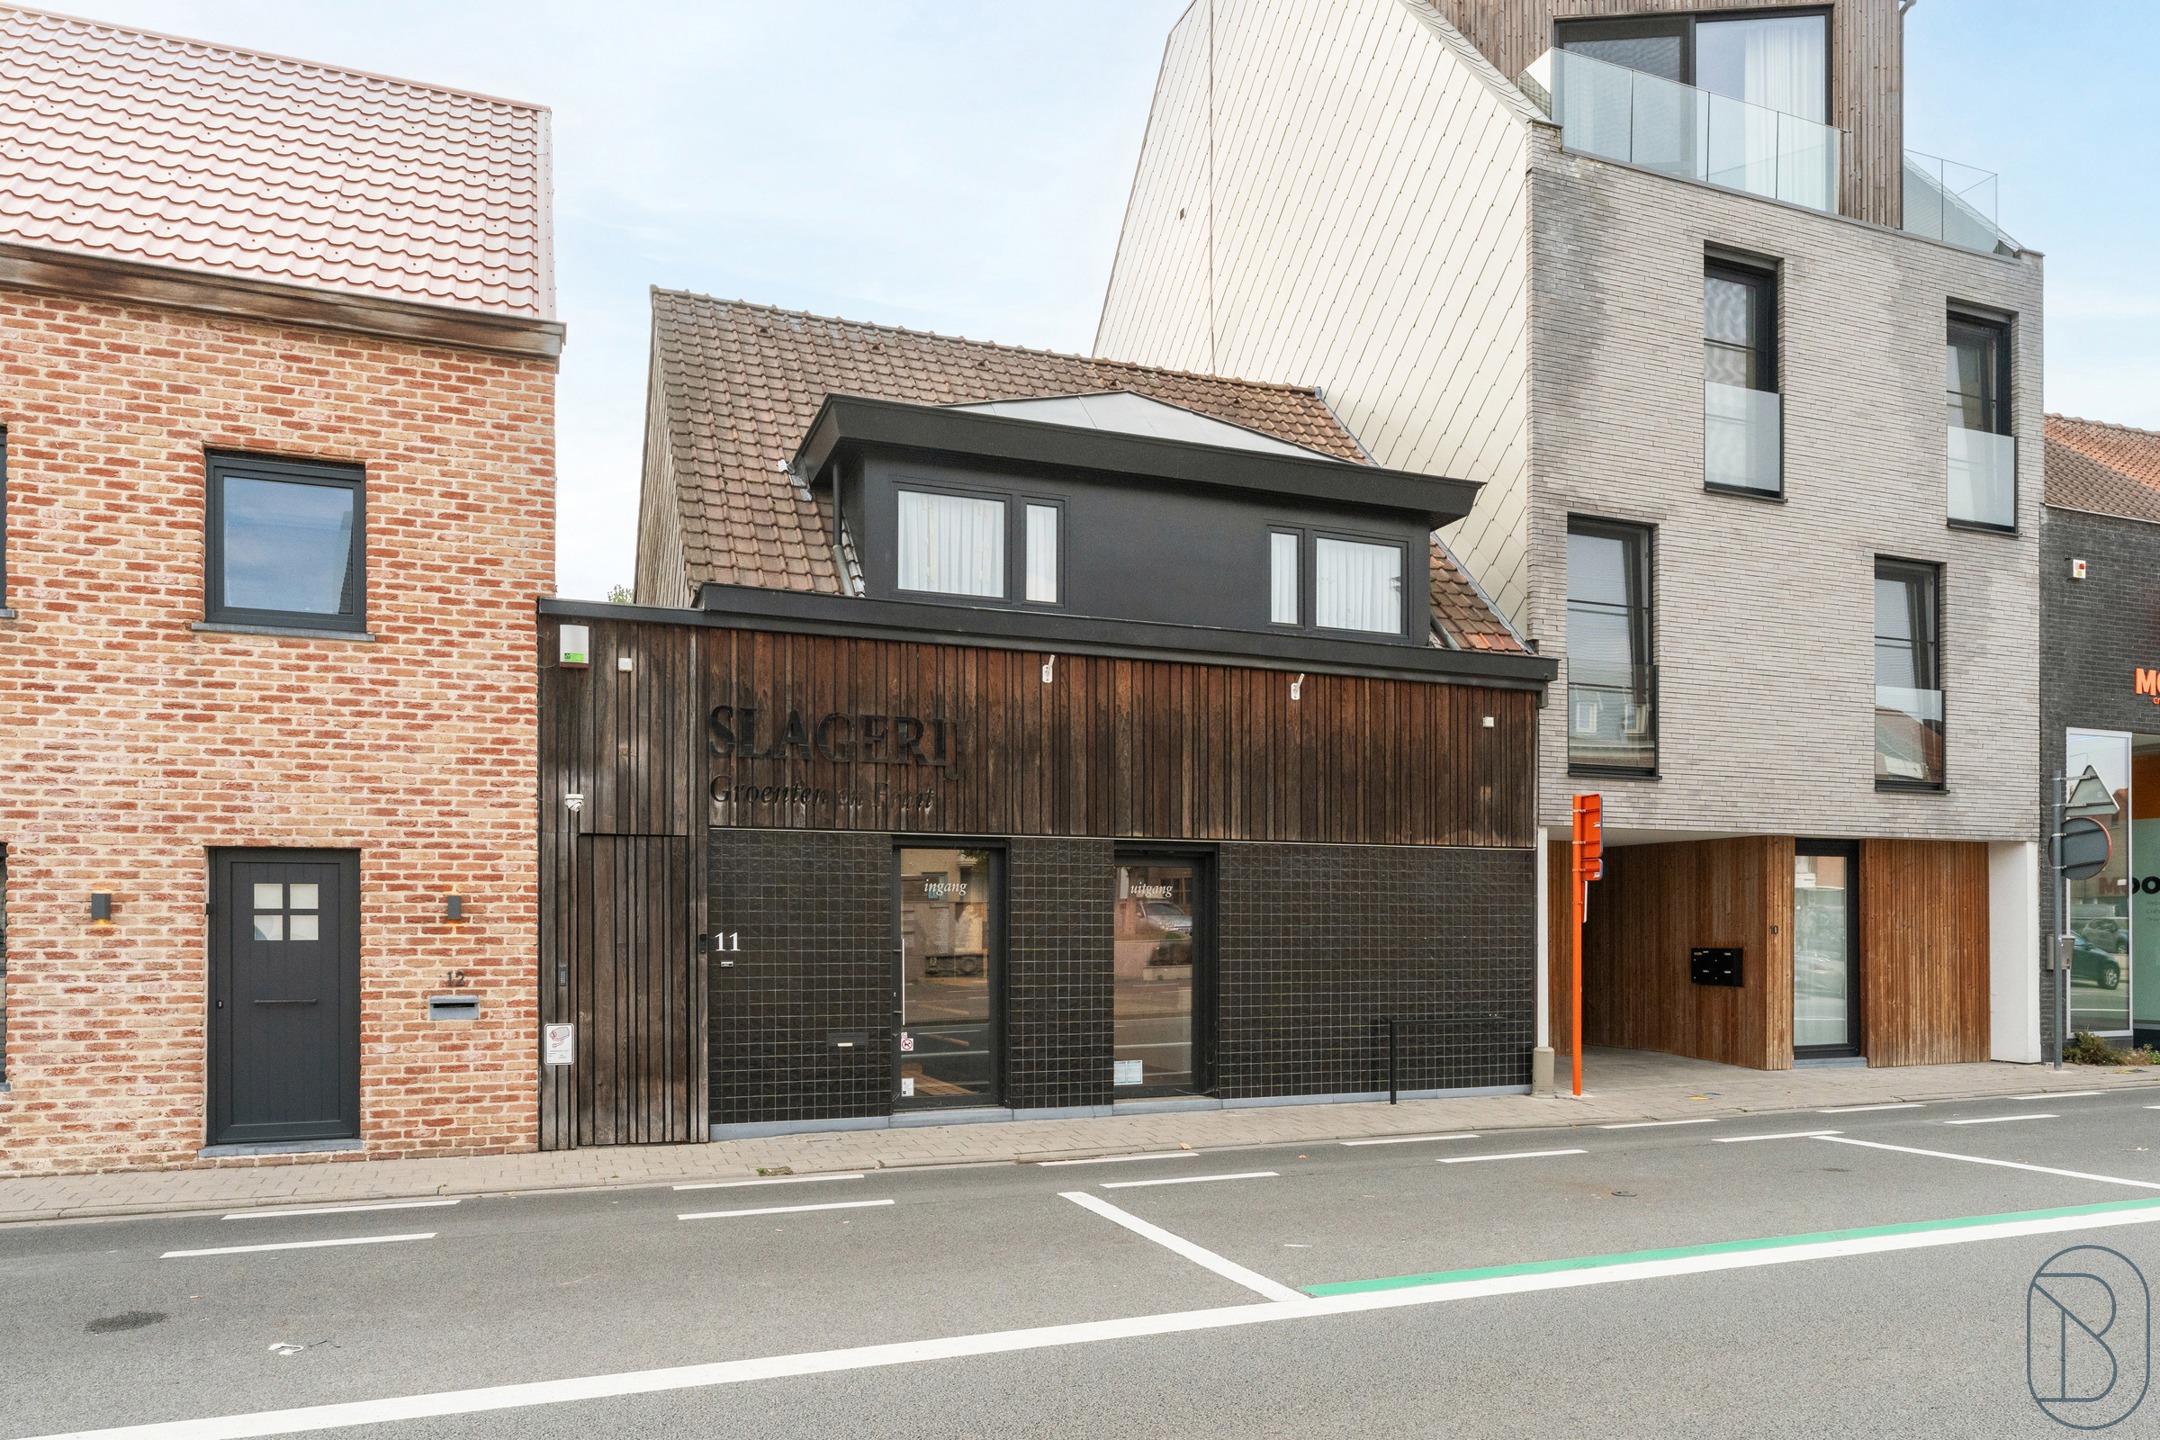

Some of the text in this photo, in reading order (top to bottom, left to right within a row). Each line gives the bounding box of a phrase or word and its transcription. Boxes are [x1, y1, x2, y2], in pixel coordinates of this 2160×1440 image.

[2135, 667, 2160, 696] M
[710, 774, 827, 805] Groenten
[838, 790, 864, 807] en
[924, 878, 967, 896] ingang
[1130, 881, 1173, 898] uitgang
[714, 931, 741, 952] 11
[447, 970, 465, 987] 12
